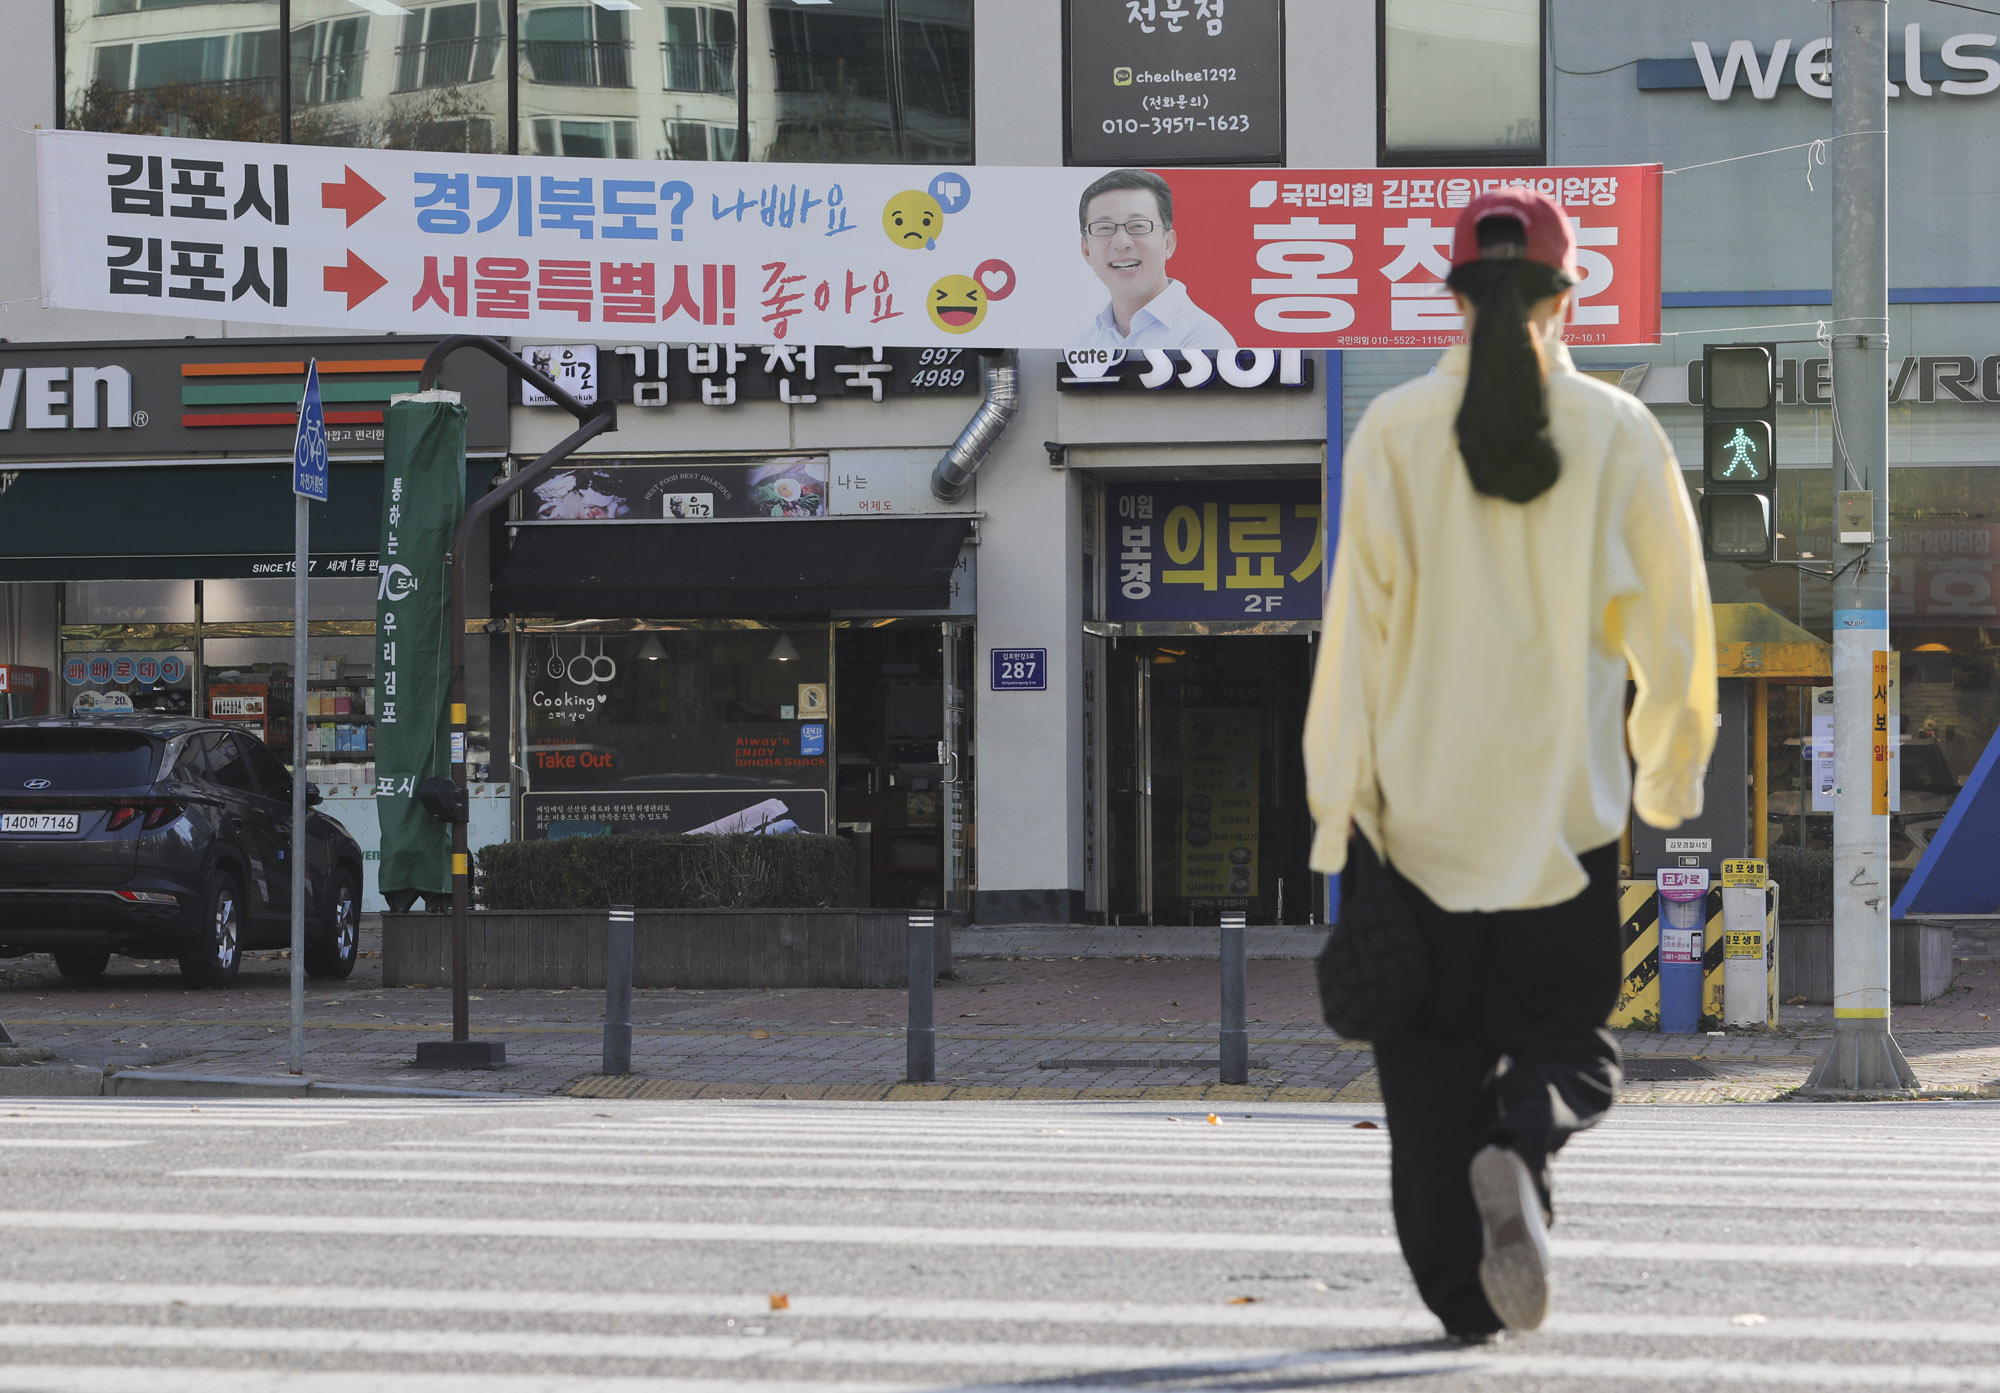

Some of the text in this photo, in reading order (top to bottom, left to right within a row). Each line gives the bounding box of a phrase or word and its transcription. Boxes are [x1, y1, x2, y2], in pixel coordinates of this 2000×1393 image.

[1126, 0, 1225, 37] 전문점
[1691, 22, 2000, 101] wels
[1136, 68, 1237, 85] cheolhee1292
[1102, 115, 1250, 135] 010-3957-1623
[106, 153, 858, 242] 김포시 경기북도? 나빠요
[1281, 182, 1374, 208] 국민의힘
[106, 234, 904, 340] 김포시 서울특별시! 좋아요
[1337, 336, 1370, 345] 국민의힘
[918, 348, 963, 366] 997
[560, 349, 594, 389] 유로
[614, 342, 893, 407] 김밥천국
[911, 369, 966, 388] 4989
[300, 472, 324, 494] 자전거횡단
[644, 472, 733, 501] BEST FOOD BEST DELICIOUS
[838, 474, 868, 490] 나는
[859, 500, 893, 512] 어제도
[1118, 494, 1153, 519] 이원
[387, 477, 403, 556] 통하는
[285, 560, 317, 573] 197
[327, 559, 348, 572] 세계
[350, 557, 366, 572] 1등
[1119, 525, 1152, 600] 보경
[396, 578, 418, 591] 도시
[1244, 595, 1284, 613] 2F
[1002, 652, 1036, 661] 김포한강3로
[67, 661, 181, 680] 빼빼로데이
[1001, 661, 1037, 679] 287
[533, 690, 596, 712] Cooking
[548, 711, 577, 723] 스페셜
[735, 736, 790, 748] Alway's
[535, 750, 613, 769] Take Out
[735, 747, 775, 758] ENJOY
[735, 756, 827, 768] lunch&Snack
[536, 803, 671, 813] 매일매일 신선한 재료와 철저한 위생관리로
[536, 812, 669, 822] 최소 비용으로 최대 만족을 드릴 수 있도록
[4, 816, 74, 830] 140하 7146
[1669, 840, 1708, 850] 김포경찰서장
[1724, 863, 1765, 874] 김포생활
[1664, 873, 1701, 886] 교차로
[1725, 935, 1761, 946] 김포생활
